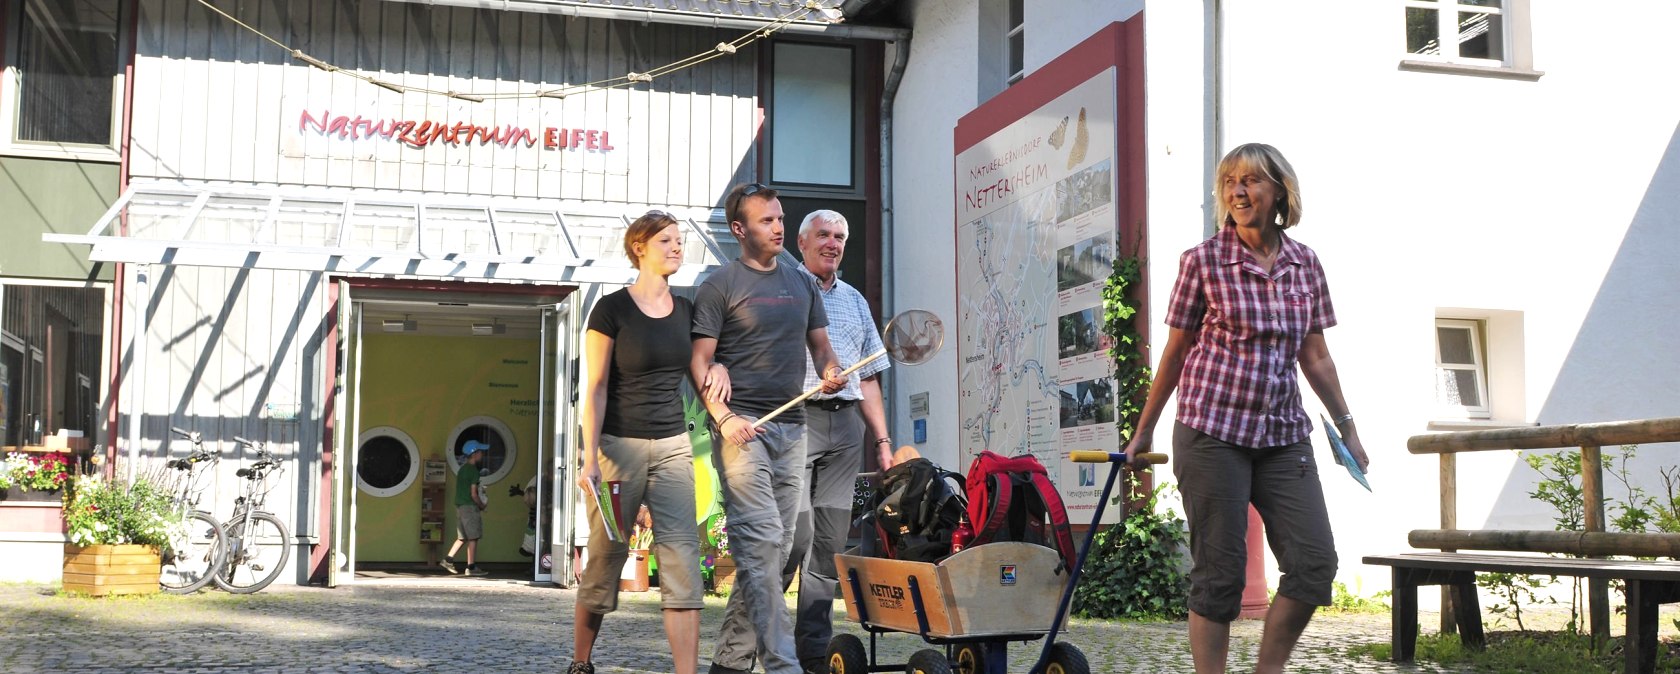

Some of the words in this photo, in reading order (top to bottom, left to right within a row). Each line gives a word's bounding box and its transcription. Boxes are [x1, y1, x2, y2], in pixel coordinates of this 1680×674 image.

[299, 109, 536, 147] Naturzentrum
[545, 127, 614, 150] EIFEL
[965, 163, 1047, 212] NETTERSHEIM
[869, 583, 905, 600] KETTLER
